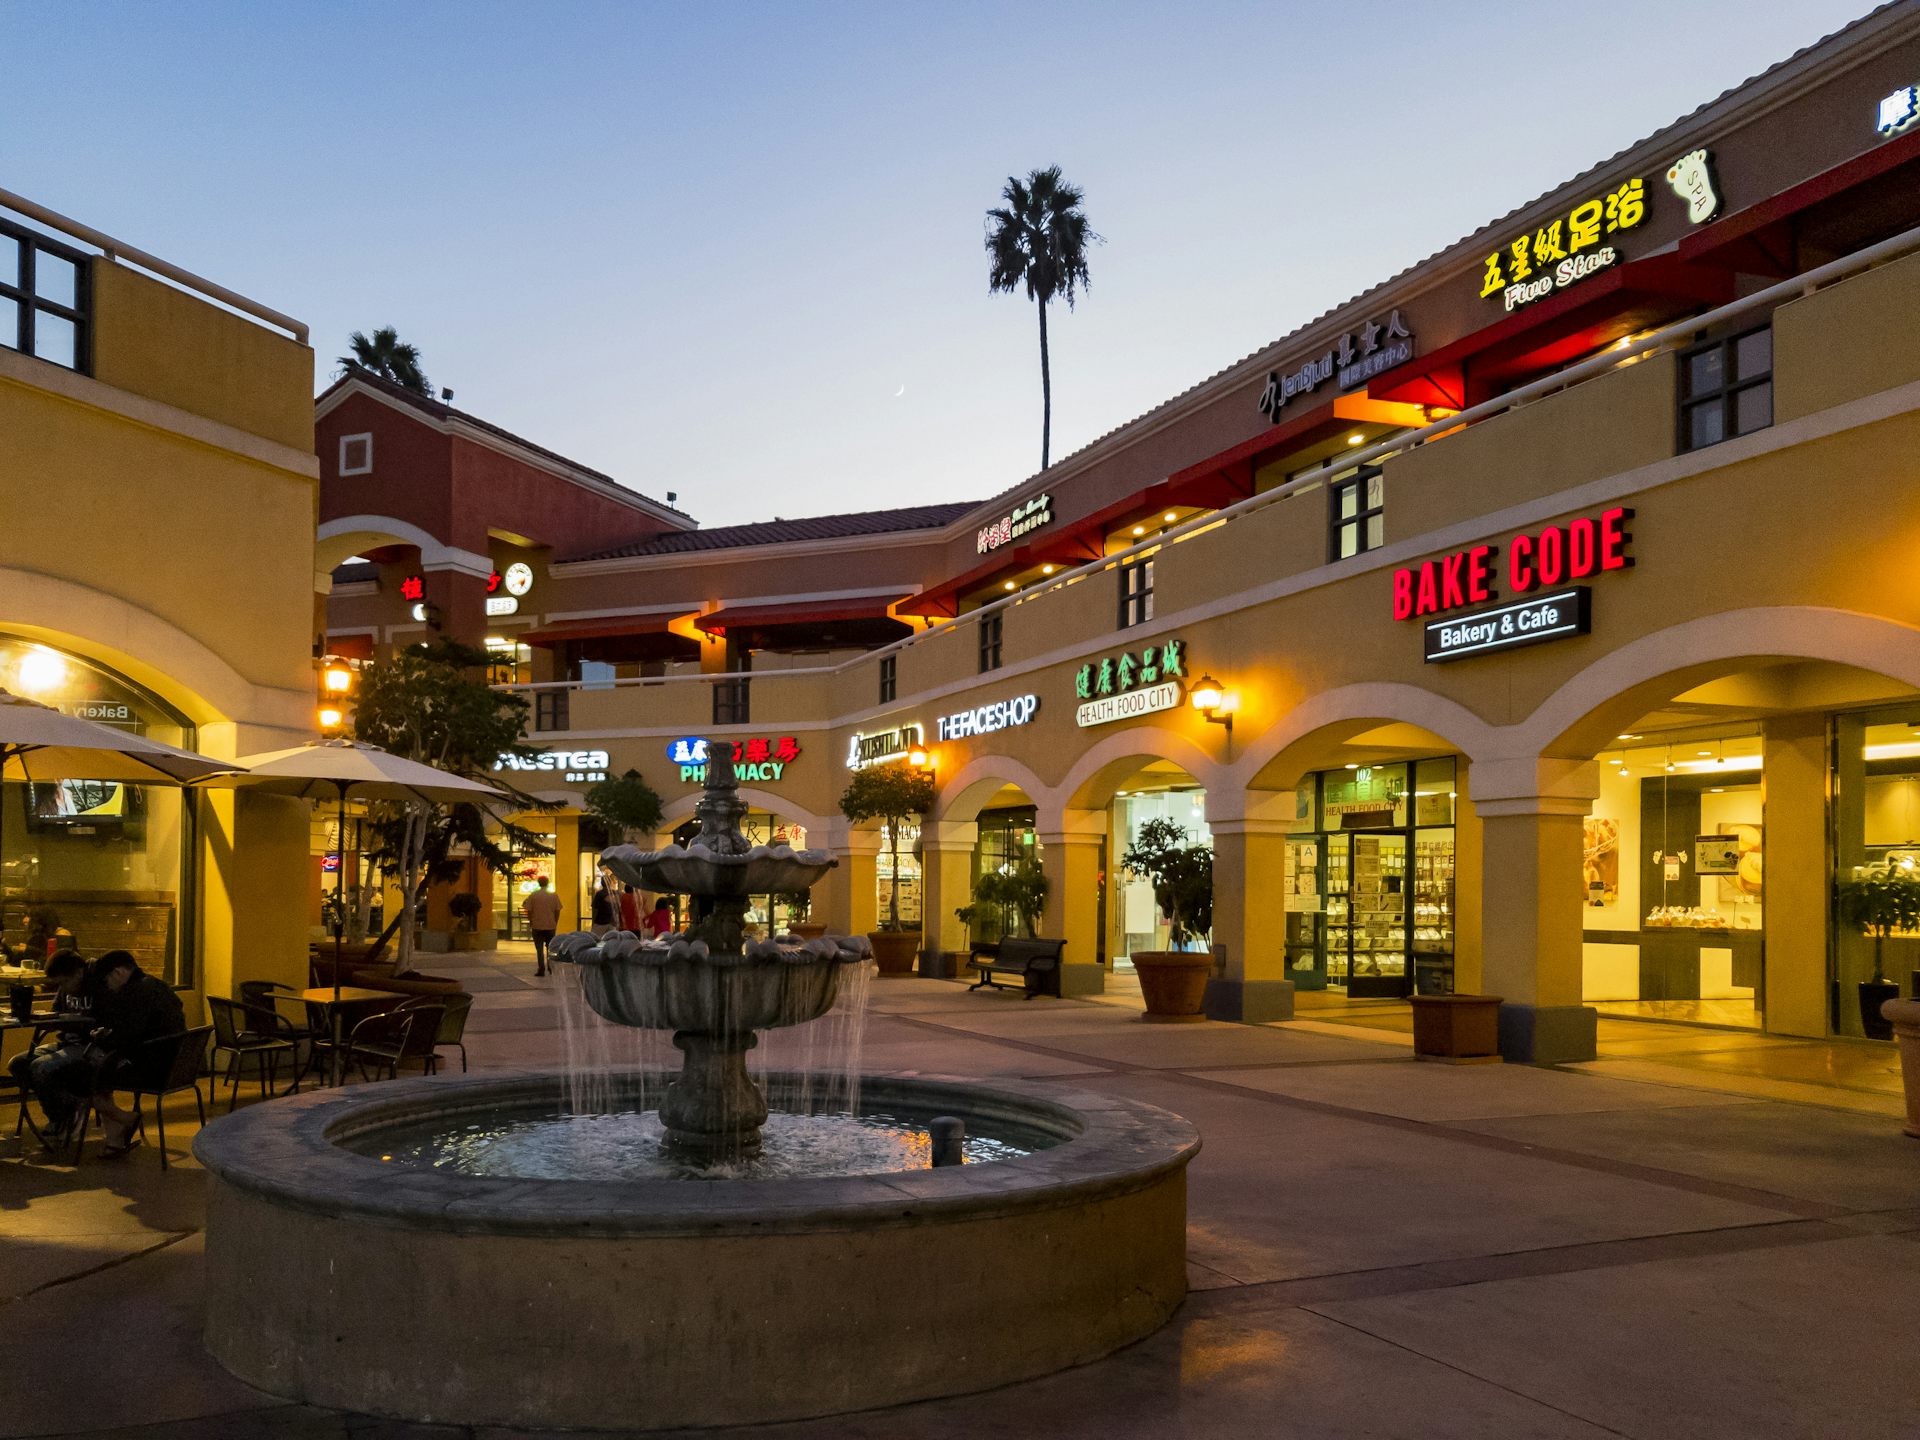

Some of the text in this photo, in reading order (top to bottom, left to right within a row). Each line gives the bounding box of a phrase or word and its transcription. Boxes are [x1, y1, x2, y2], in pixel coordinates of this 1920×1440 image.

[1687, 169, 1706, 212] SPA
[1479, 178, 1645, 299] 五星級足浴
[1504, 247, 1616, 312] Five Star
[1393, 507, 1625, 621] BAKE CODE
[1440, 607, 1559, 649] Bakery & Cafe
[1076, 639, 1183, 698] 健康食品城
[937, 695, 1037, 741] THEFACESHOP
[1080, 685, 1175, 725] HEALTH FOOD CITY
[680, 763, 784, 782] PHMACY
[1304, 847, 1313, 857] A
